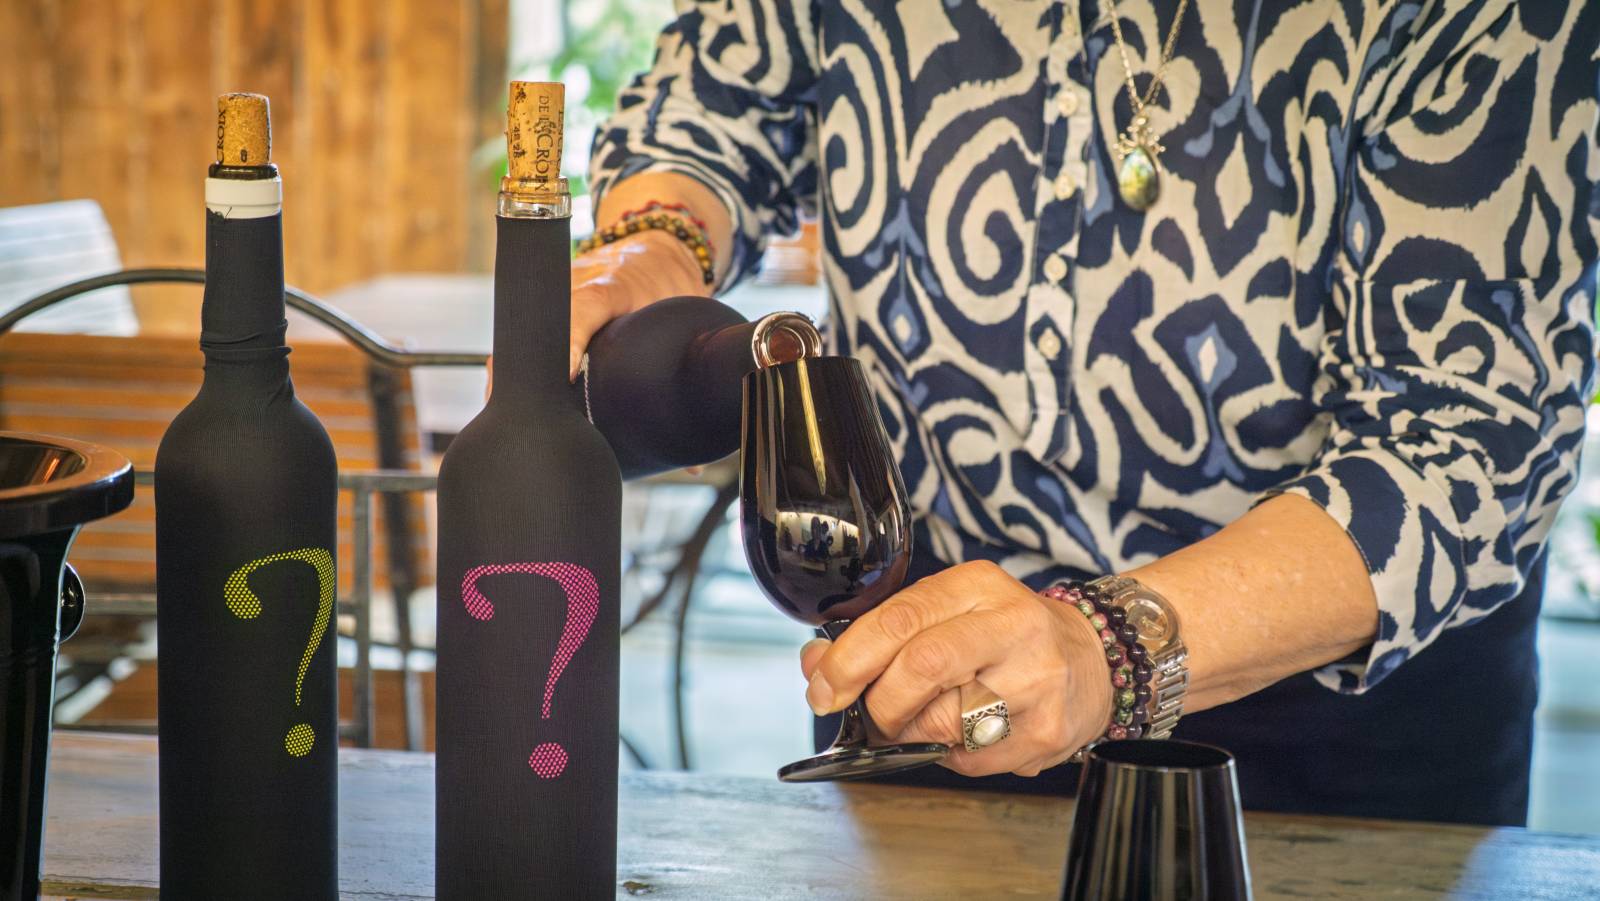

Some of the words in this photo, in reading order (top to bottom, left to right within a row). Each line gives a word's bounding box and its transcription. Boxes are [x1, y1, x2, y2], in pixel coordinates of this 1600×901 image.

[538, 95, 550, 113] DE
[224, 547, 336, 758] ?
[461, 560, 600, 780] ?
